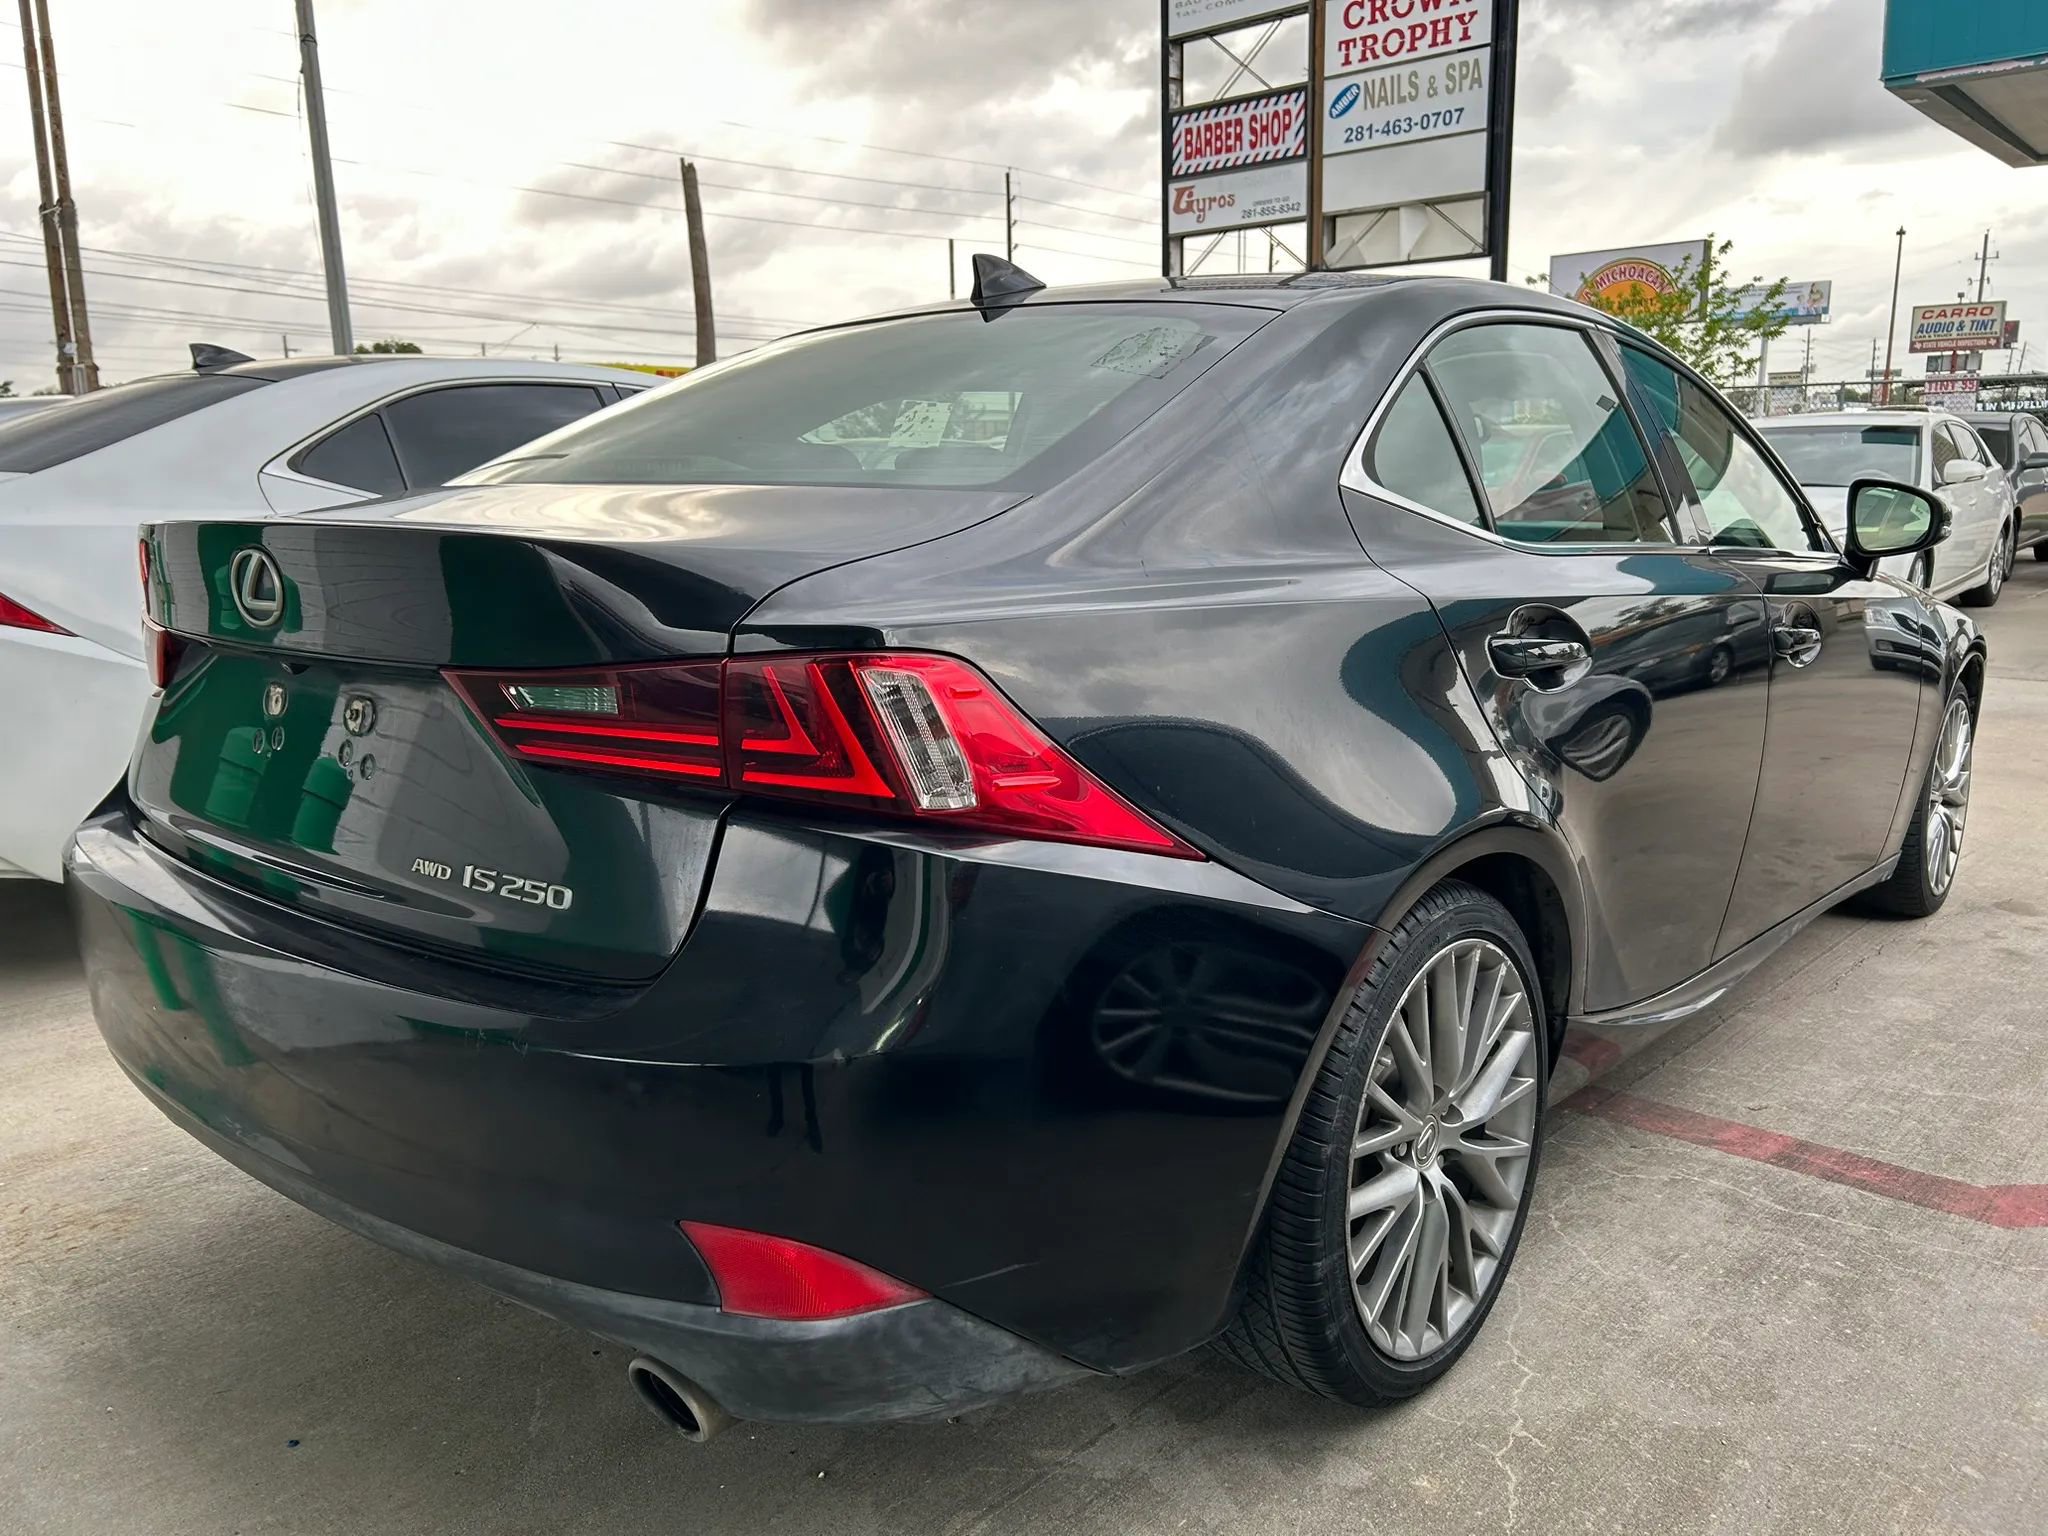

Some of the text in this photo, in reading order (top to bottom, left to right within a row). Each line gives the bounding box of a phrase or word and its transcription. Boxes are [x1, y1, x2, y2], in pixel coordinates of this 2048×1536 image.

[1338, 10, 1478, 66] TROPHY
[1364, 58, 1483, 110] NAILS & SPA
[1184, 108, 1292, 161] BARBER SHOP
[1344, 107, 1465, 143] 281-463-0707
[1172, 185, 1235, 224] Gyros
[1916, 321, 1955, 334] AUDIO
[1956, 320, 1965, 332] &
[1969, 319, 1997, 331] TINT
[1921, 306, 1994, 320] CARRO
[410, 858, 574, 911] AWD IS 250
